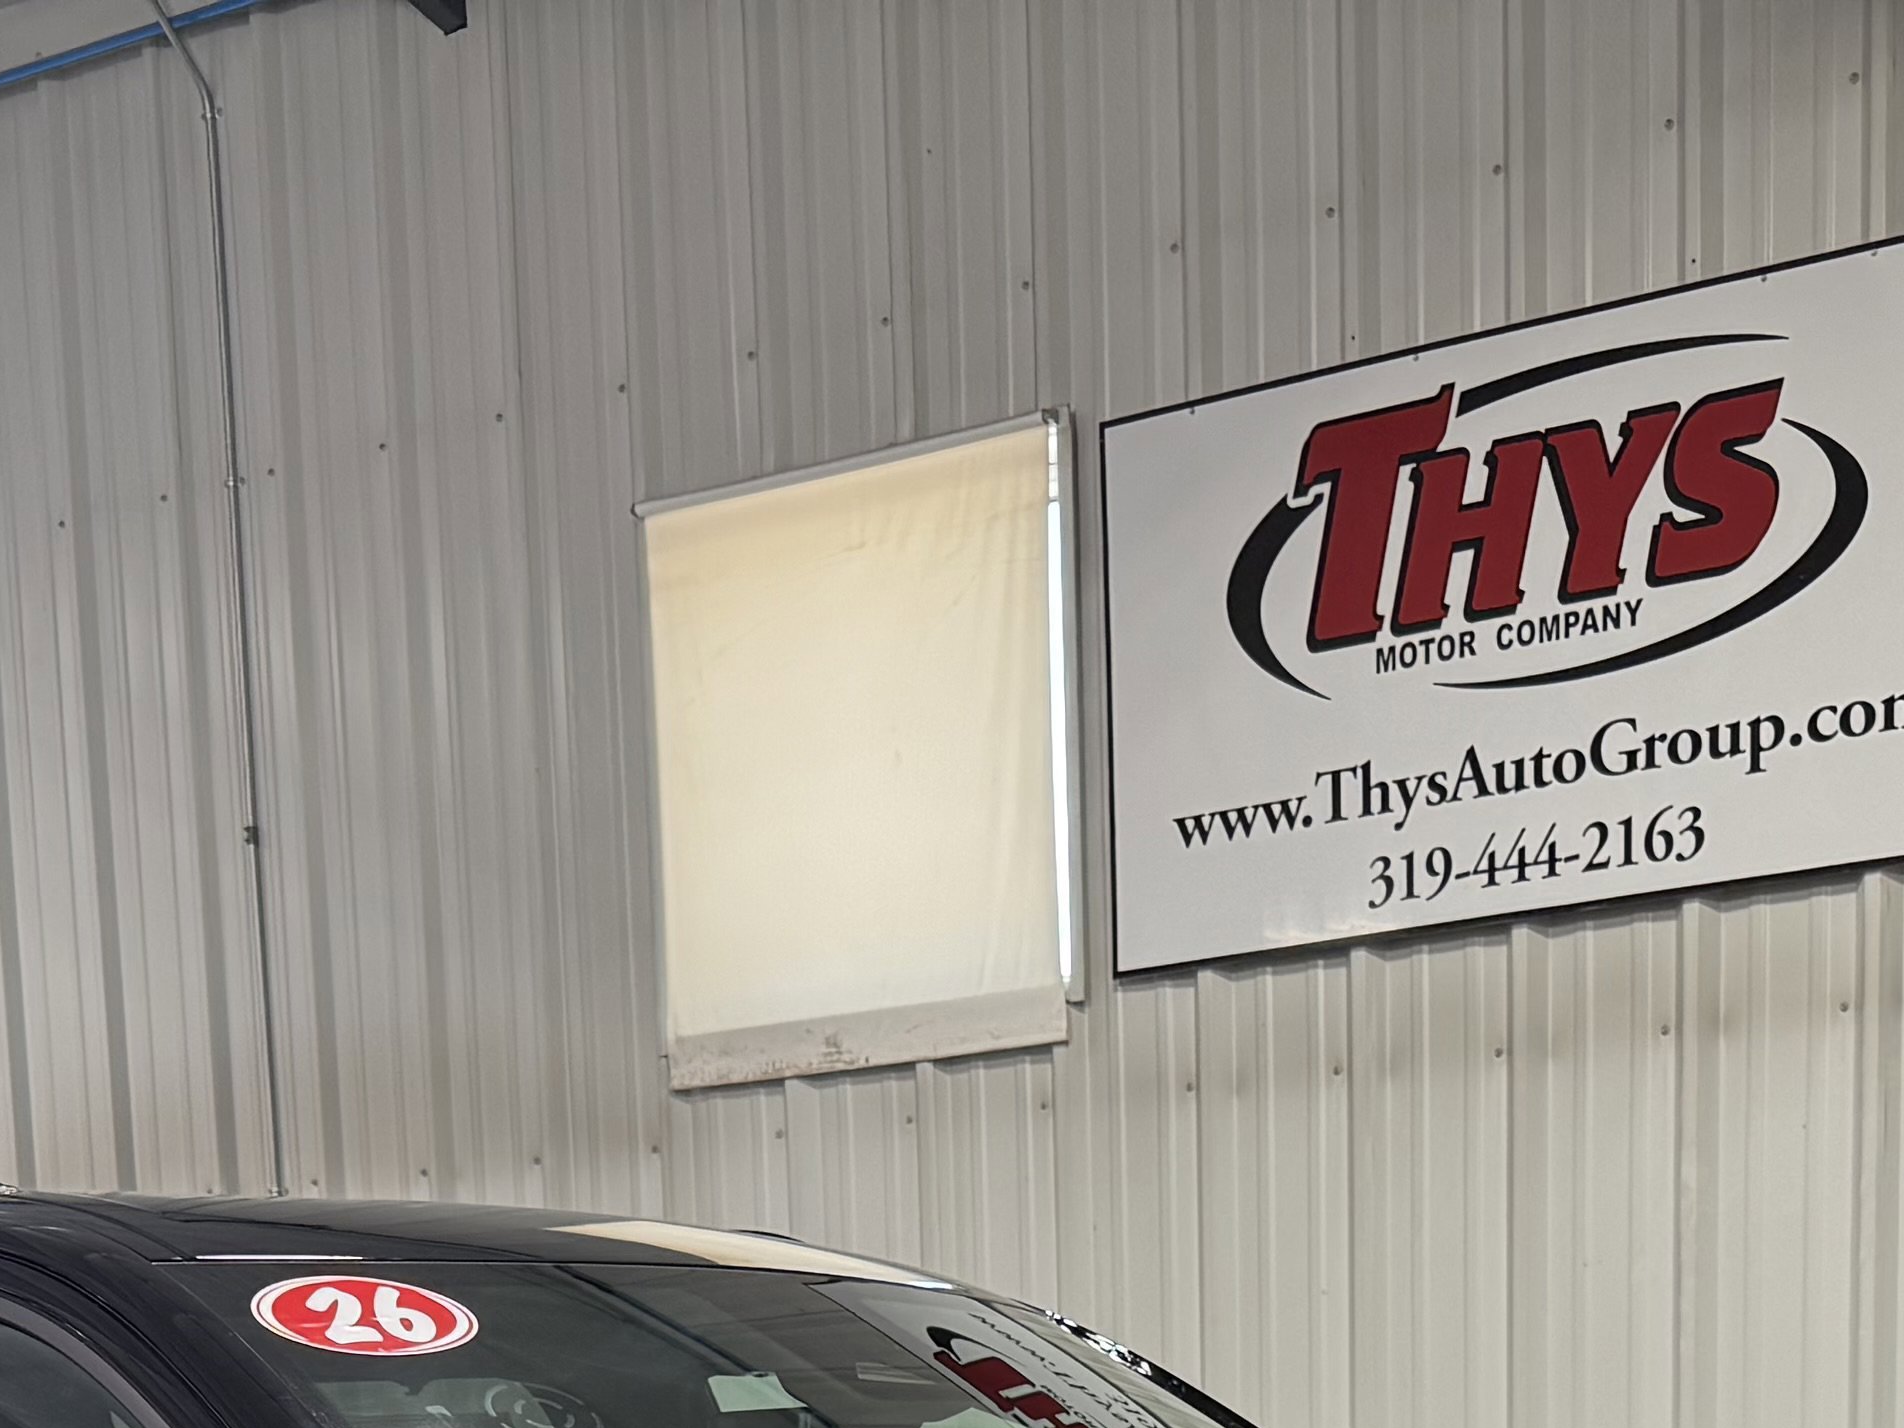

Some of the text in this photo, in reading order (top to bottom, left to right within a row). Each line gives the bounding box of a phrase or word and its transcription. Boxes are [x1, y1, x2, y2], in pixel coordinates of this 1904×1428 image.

[1295, 376, 1786, 653] THYS
[1374, 597, 1644, 675] MOTOR COMPANY
[1367, 804, 1706, 910] 319-444-2163
[305, 1286, 437, 1345] 26
